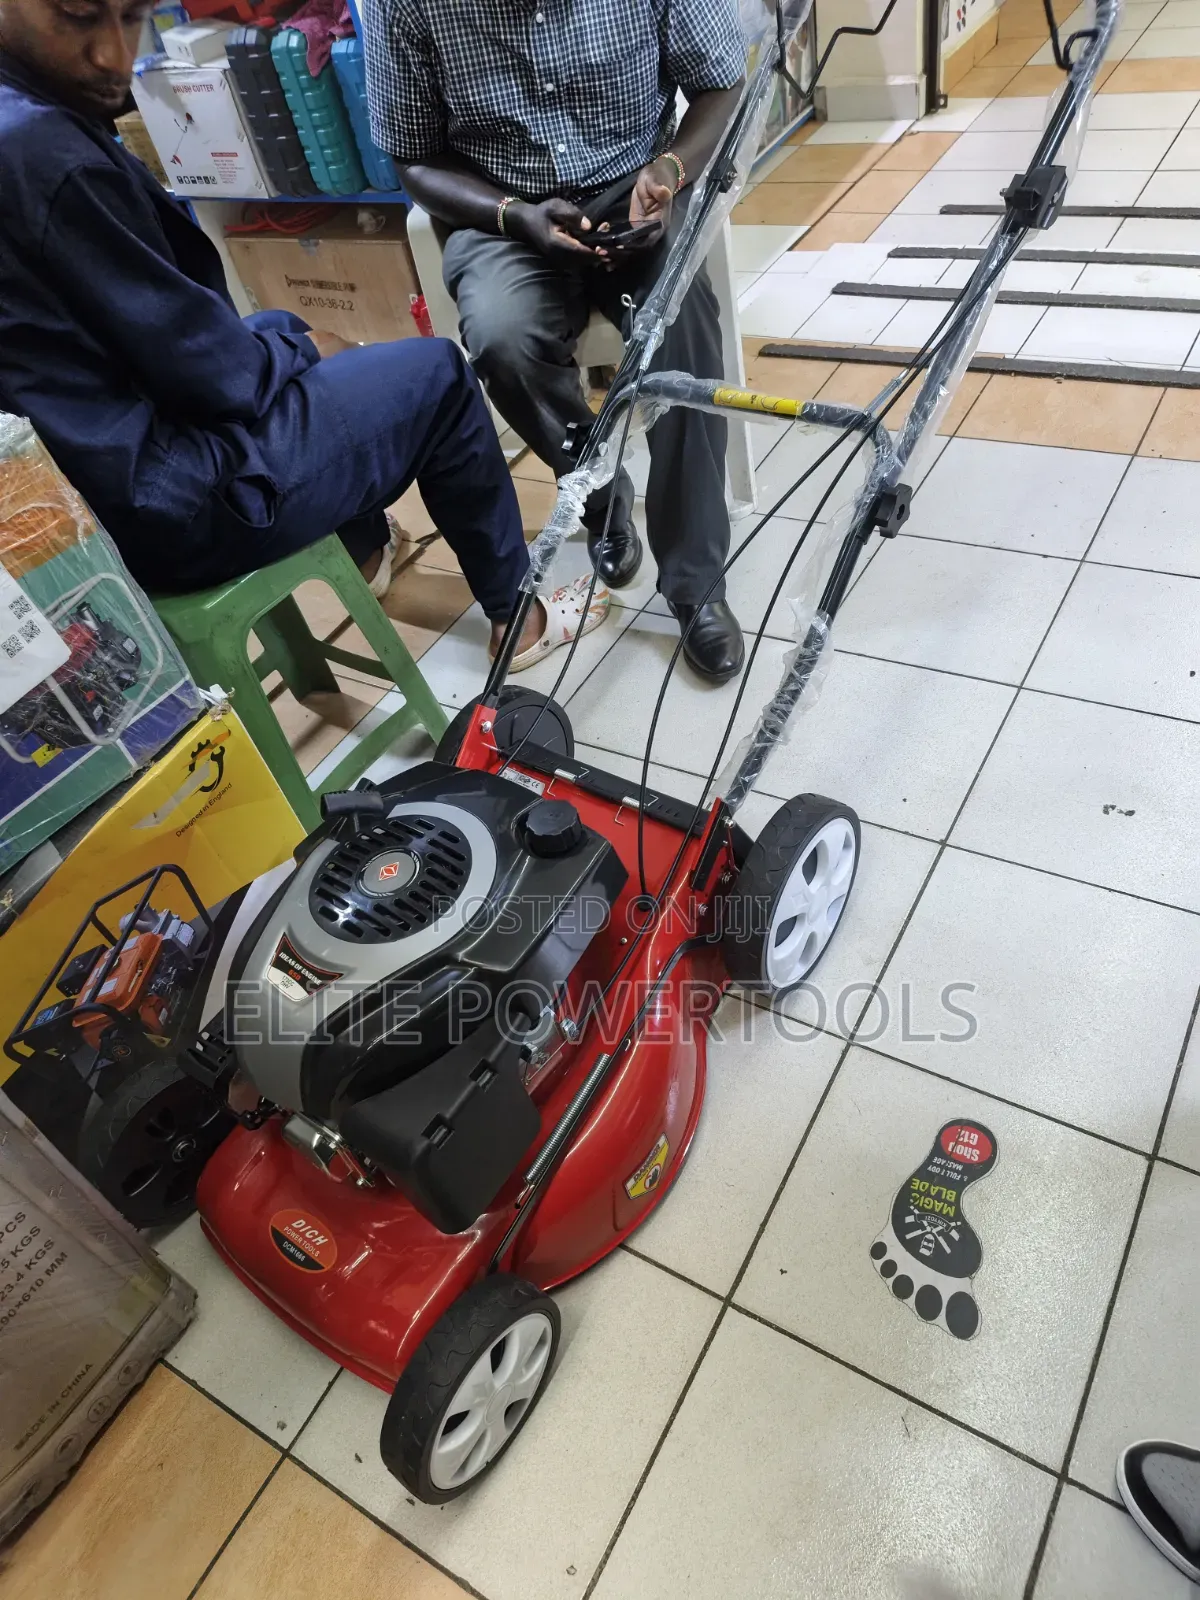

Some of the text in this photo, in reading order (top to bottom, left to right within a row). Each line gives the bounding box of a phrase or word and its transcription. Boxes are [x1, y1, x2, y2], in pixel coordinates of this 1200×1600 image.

[173, 83, 215, 94] BRUSH CUTTER
[175, 782, 233, 837] Designed in England
[278, 951, 323, 986] IDEAS OF ENGINE
[955, 1128, 979, 1145] G12
[948, 1141, 981, 1162] Shop
[946, 1170, 962, 1181] FULL
[910, 1178, 957, 1202] BLADE
[911, 1192, 956, 1217] MAGIC
[10, 1225, 41, 1258] KGS
[283, 1226, 321, 1257] POWER TOOLS
[291, 1219, 329, 1246] DICH
[25, 1239, 55, 1270] KGS
[45, 1251, 68, 1277] MM
[61, 1363, 94, 1399] CHINA
